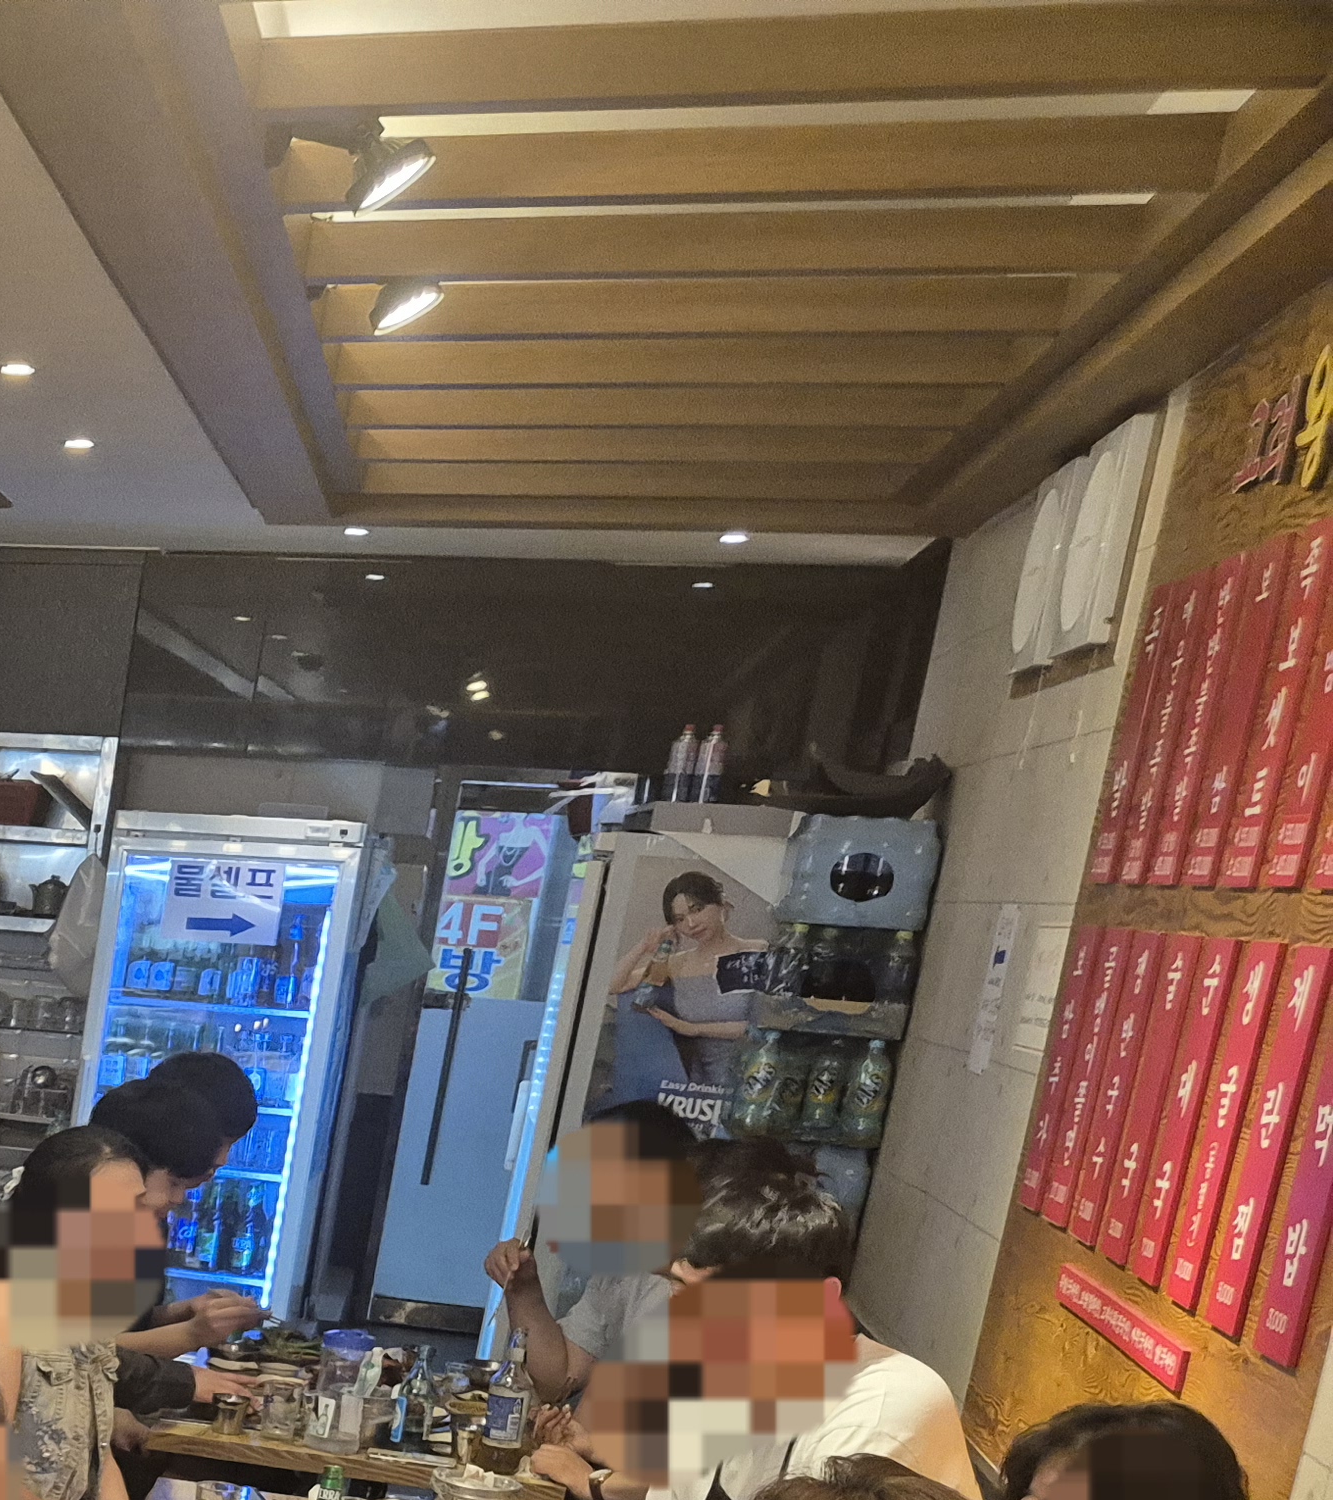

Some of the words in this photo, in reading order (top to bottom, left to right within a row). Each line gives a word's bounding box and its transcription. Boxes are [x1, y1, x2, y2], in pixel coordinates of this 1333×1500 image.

[174, 864, 276, 900] 물셀프
[436, 901, 505, 945] 4F
[439, 948, 505, 993] 방
[660, 1080, 687, 1093] Easy
[1036, 946, 1087, 1150] 보쌈추가
[1153, 954, 1221, 1221] 순대국
[1217, 960, 1265, 1128] 생굴
[1231, 964, 1316, 1260] 계란찜
